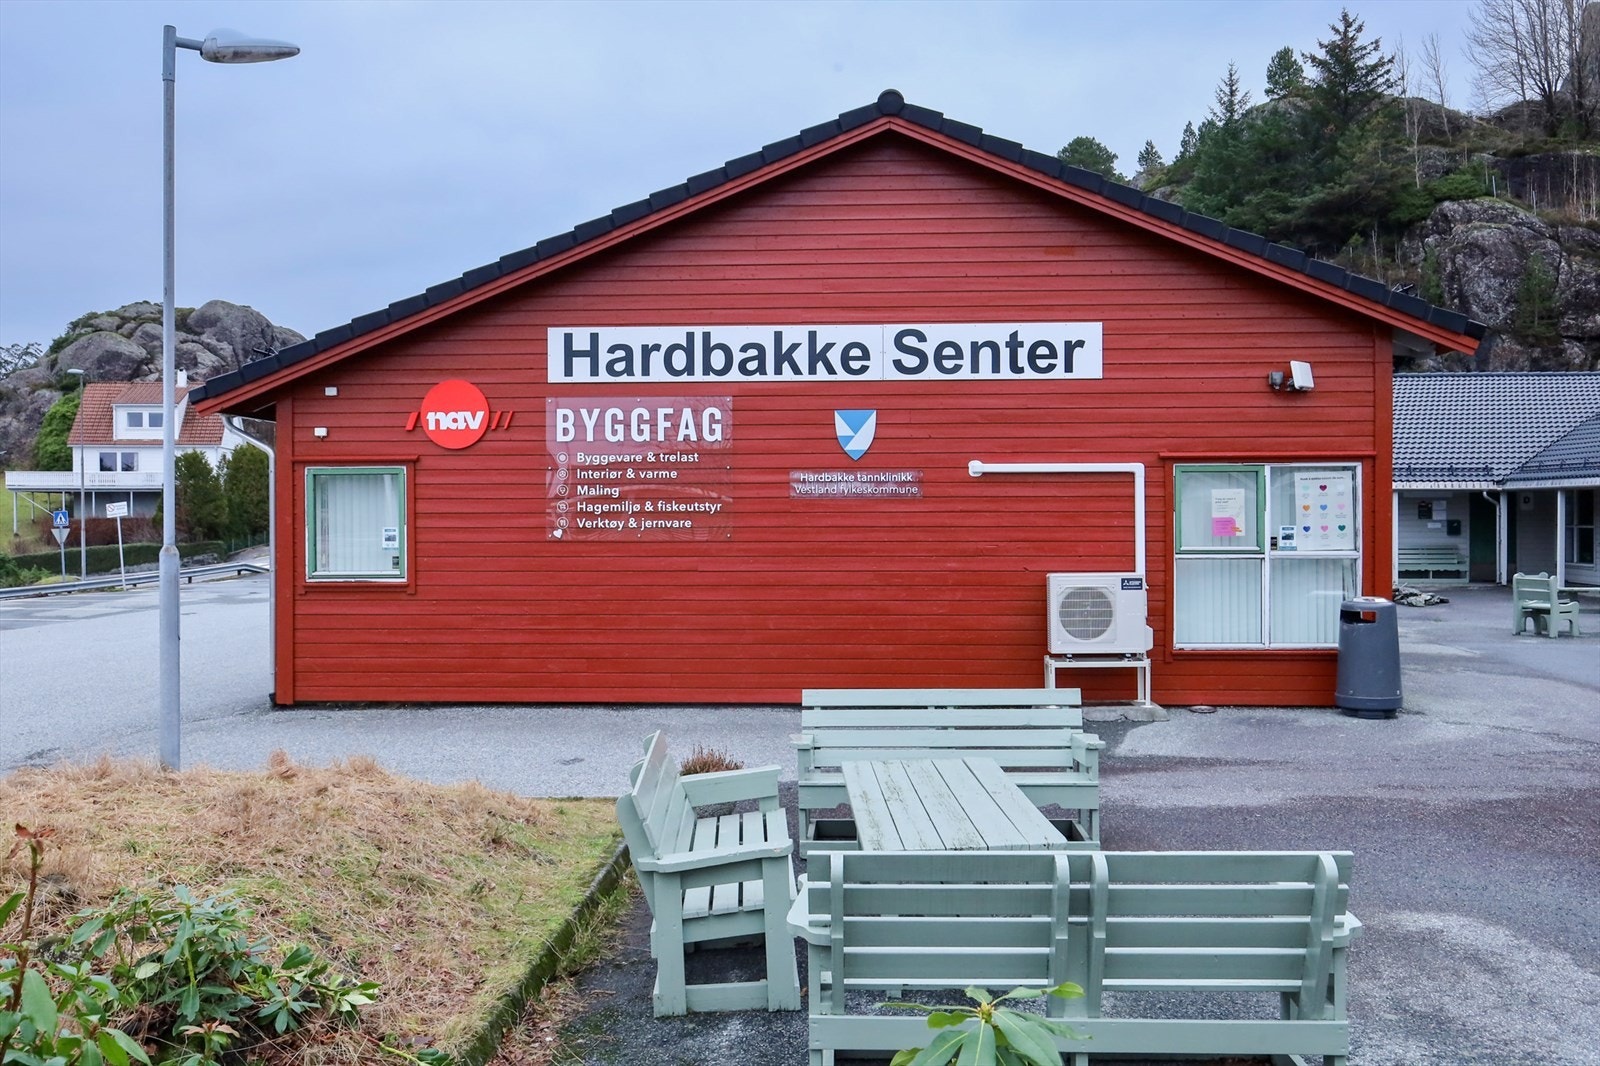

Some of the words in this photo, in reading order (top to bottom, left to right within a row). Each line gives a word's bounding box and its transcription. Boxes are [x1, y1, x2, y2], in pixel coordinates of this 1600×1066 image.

[563, 330, 871, 377] Hardbakke
[892, 328, 1086, 375] Senter
[426, 410, 485, 431] nav
[556, 407, 722, 442] BYGGFAG
[577, 452, 643, 465] Byggevare
[647, 452, 656, 463] &
[660, 452, 699, 463] trelast
[577, 468, 622, 479] Interiør
[626, 468, 635, 479] &
[639, 470, 678, 479] varme
[800, 472, 855, 482] Hardbakke
[857, 472, 913, 482] tannklinikk
[577, 485, 620, 498] Maling
[795, 484, 837, 494] Vestland
[840, 484, 918, 496] fylkeskommune
[577, 501, 640, 515] Hagemiljø
[644, 501, 654, 512] &
[657, 500, 722, 514] fiskeutstyr
[576, 517, 625, 530] Verktøy
[628, 518, 638, 528] &
[640, 518, 692, 531] jernvare
